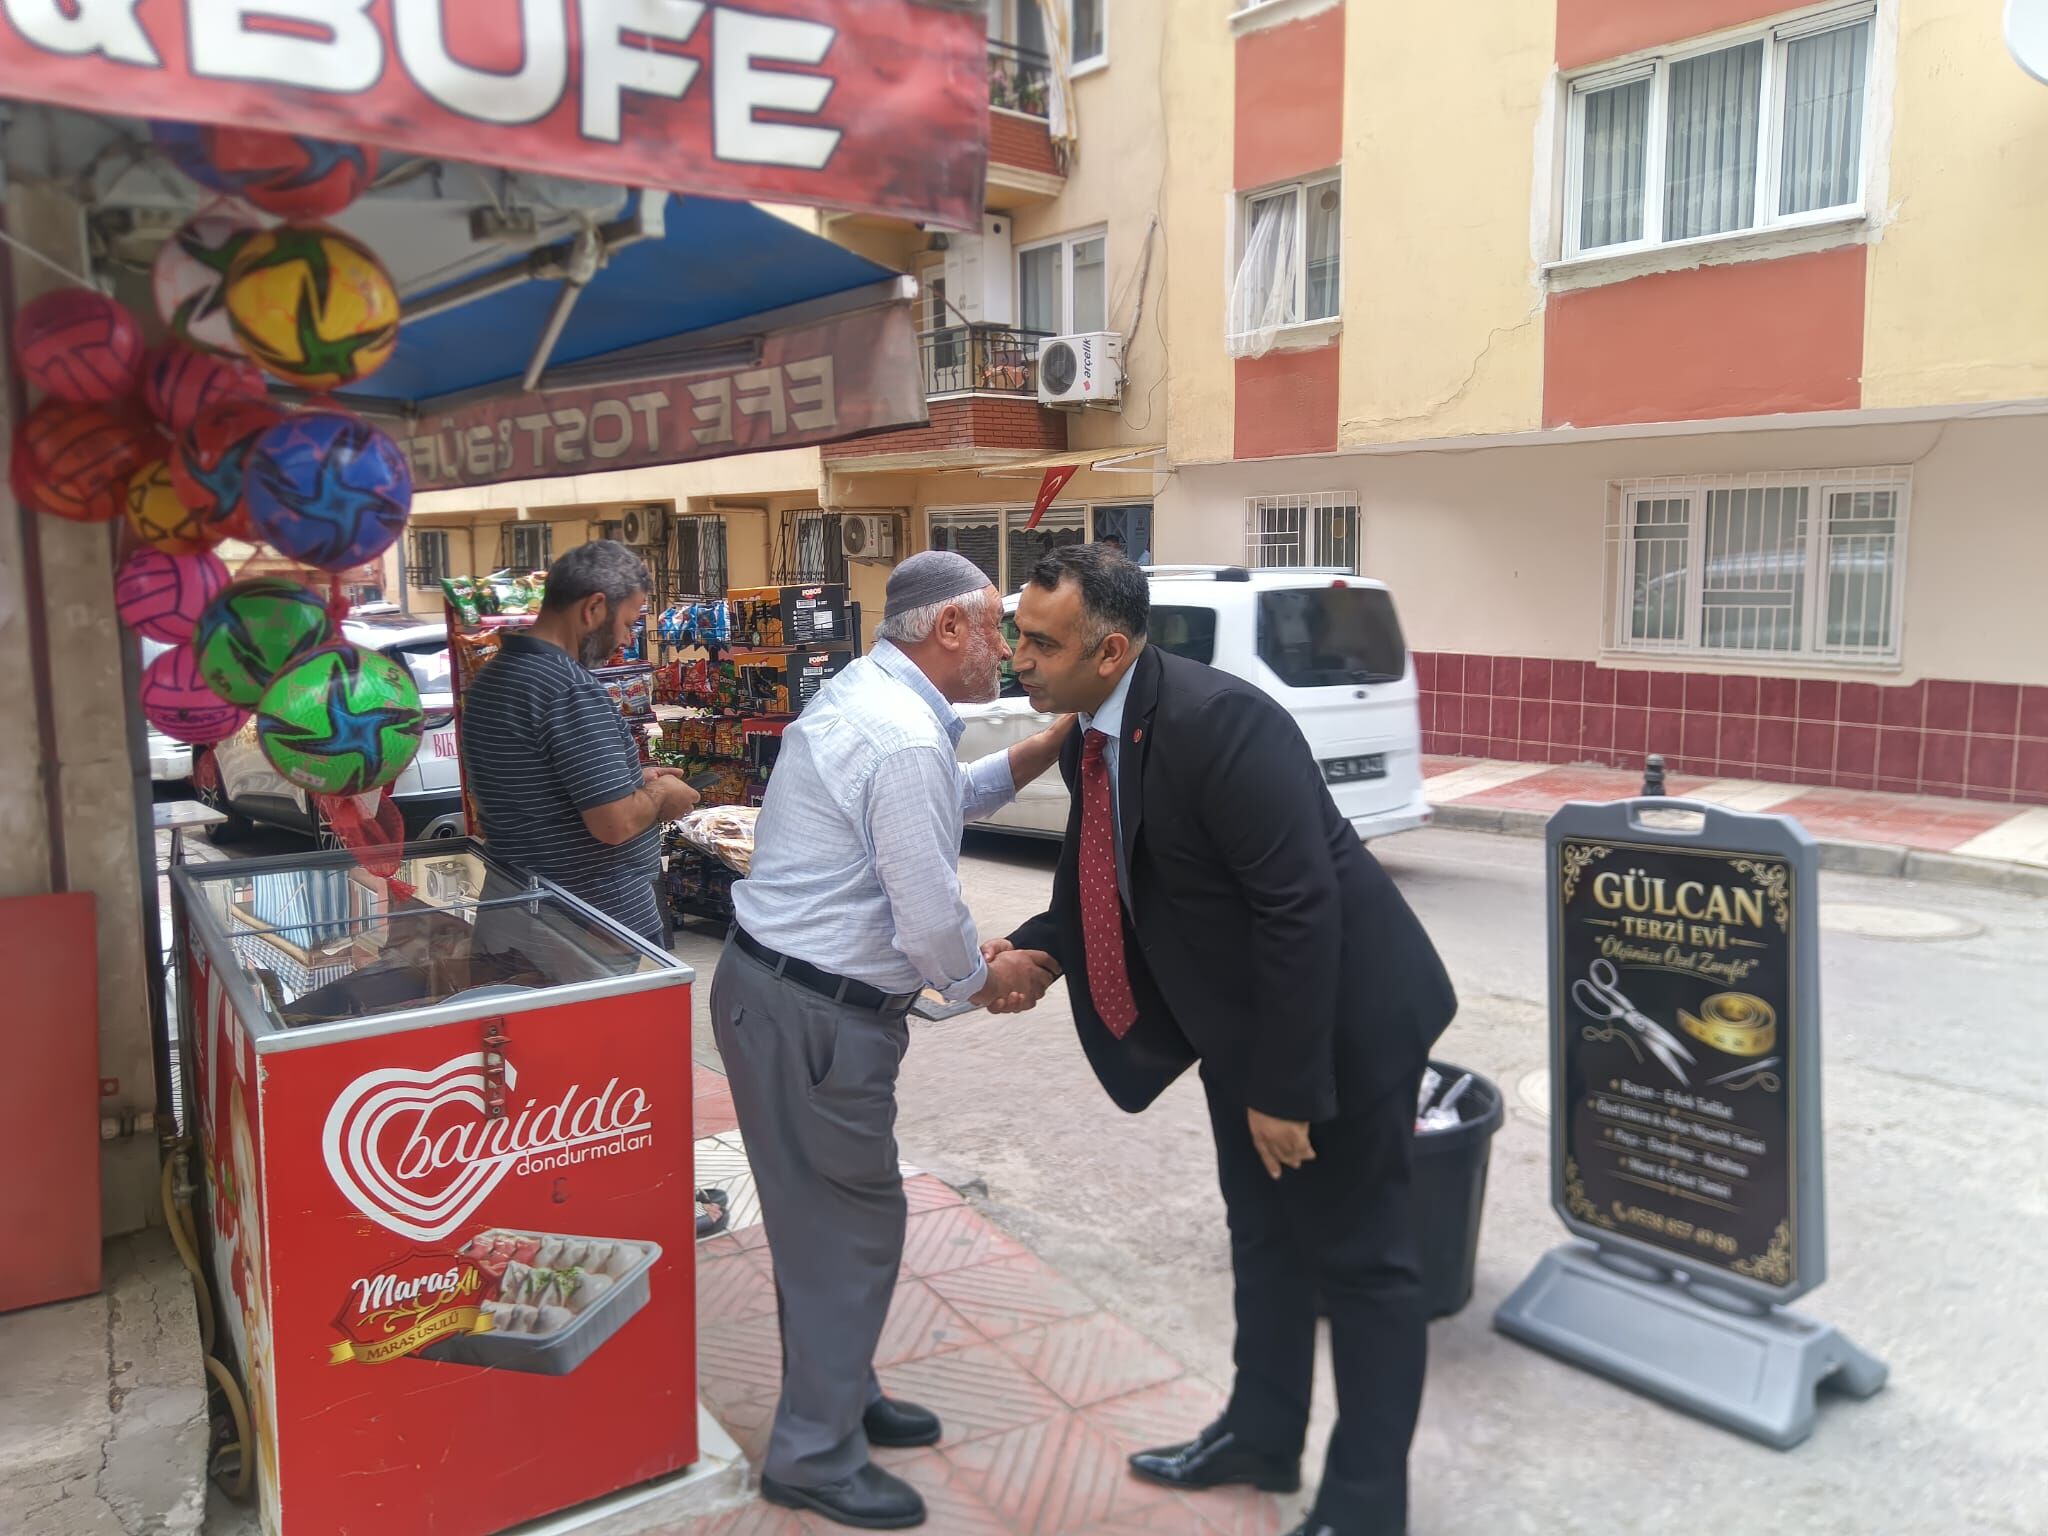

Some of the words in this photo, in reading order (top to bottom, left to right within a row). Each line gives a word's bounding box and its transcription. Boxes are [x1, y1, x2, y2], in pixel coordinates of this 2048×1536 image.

[1083, 338, 1092, 378] arçelik
[1593, 867, 1765, 929] GÜLCAN
[1620, 915, 1685, 943] TERZİ
[1690, 925, 1727, 950] EVİ
[516, 1130, 653, 1177] dondurmaları
[351, 1266, 460, 1315] Maraş
[365, 1335, 416, 1362] MARAŞ
